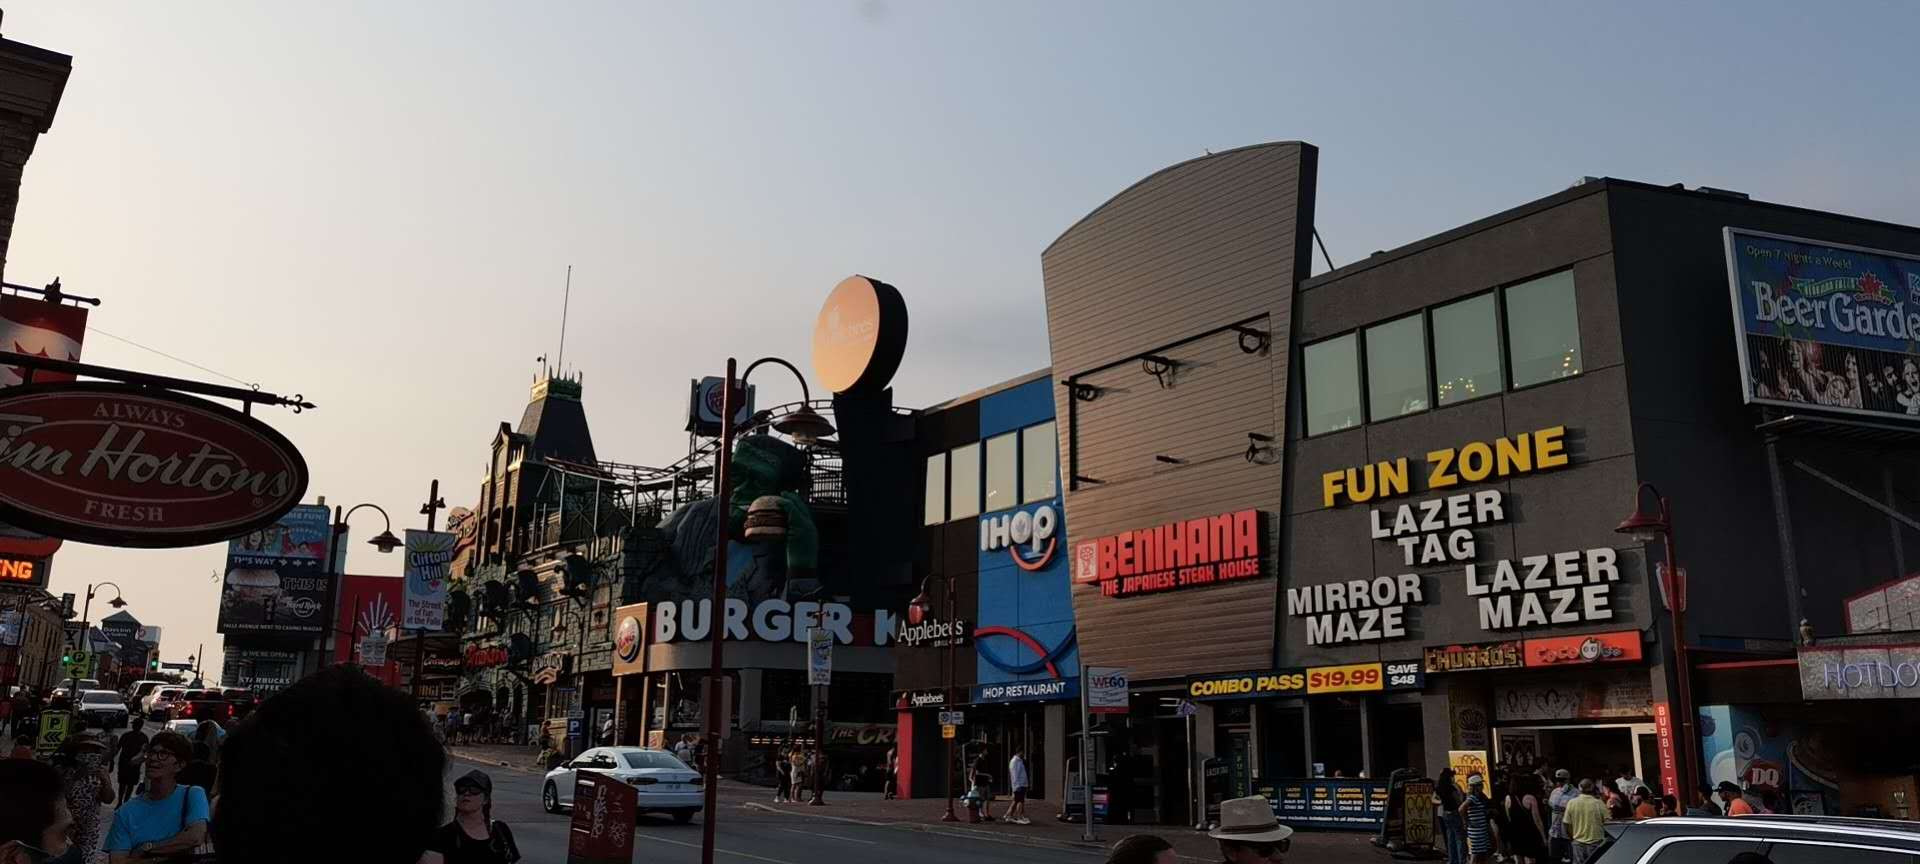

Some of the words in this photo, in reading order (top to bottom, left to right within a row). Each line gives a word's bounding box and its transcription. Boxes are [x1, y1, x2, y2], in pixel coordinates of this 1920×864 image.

[1751, 281, 1827, 329] Beer
[93, 402, 185, 429] ALWAYS
[79, 423, 289, 498] Hortons
[1321, 457, 1409, 507] FUN
[1426, 425, 1569, 489] ZONE
[83, 500, 165, 522] FRESH
[1370, 489, 1504, 540] LAZER
[1097, 508, 1259, 580] BENIHANA
[1397, 528, 1477, 566] TAG
[0, 559, 33, 579] NG
[233, 555, 254, 564] THIS
[255, 556, 275, 566] WAY
[410, 549, 450, 567] Clifton
[420, 563, 443, 580] Hill
[1100, 581, 1119, 597] THE
[1122, 571, 1176, 594] JAPANESE
[1179, 564, 1216, 584] STEAK
[1218, 559, 1260, 581] HOUSE
[1465, 547, 1620, 597] LAZER
[1287, 573, 1423, 616] MIRROR
[1478, 584, 1613, 630] MAZE
[655, 599, 854, 645] BURGER
[1305, 606, 1406, 646] MAZE
[1386, 662, 1419, 675] SAVE
[1425, 648, 1518, 671] CHURROS
[982, 687, 1005, 699] IHOP
[1006, 682, 1067, 697] RESTAURANT
[1092, 675, 1125, 688] WEGO
[1190, 677, 1254, 697] COMBO
[1256, 672, 1305, 692] PASS
[1310, 668, 1379, 688] $19.99
[1390, 674, 1416, 686] $48
[832, 727, 857, 740] THE
[1658, 706, 1672, 769] BUBBLE
[1751, 767, 1779, 788] DQ
